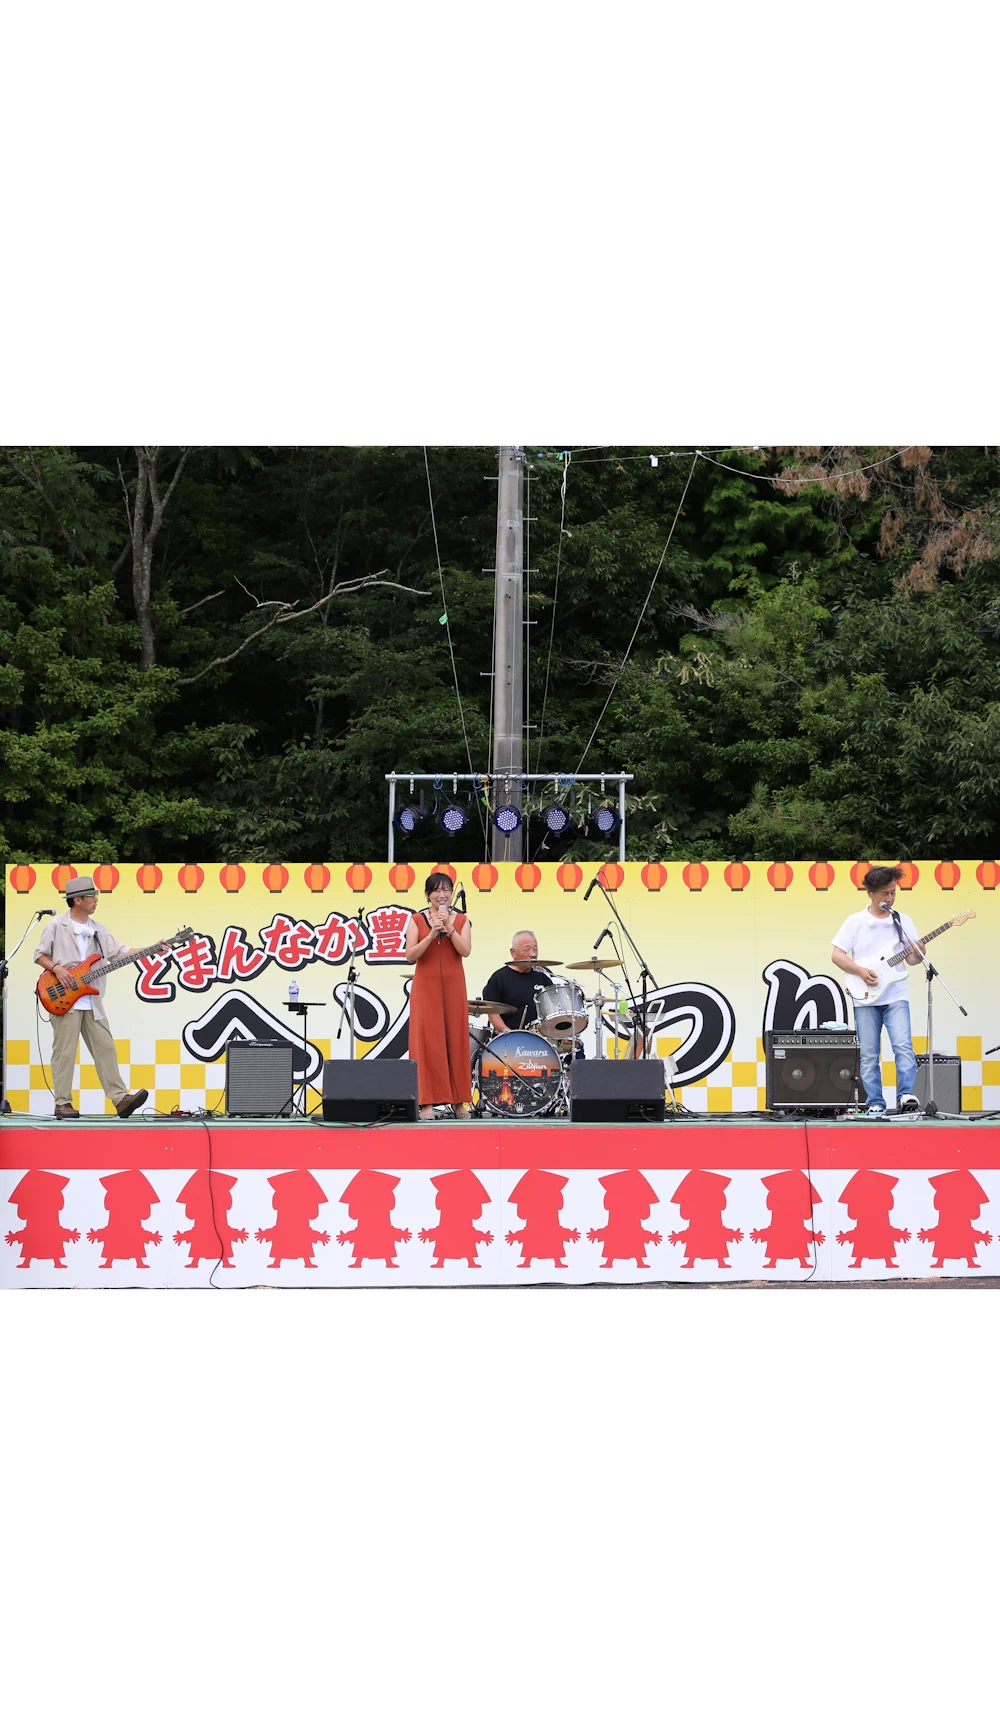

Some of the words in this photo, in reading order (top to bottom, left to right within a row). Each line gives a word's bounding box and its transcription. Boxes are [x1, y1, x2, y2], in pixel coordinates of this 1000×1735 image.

[136, 905, 470, 1003] どまんなか豊
[515, 1046, 549, 1057] Kawara
[517, 1059, 547, 1072] Zildjian
